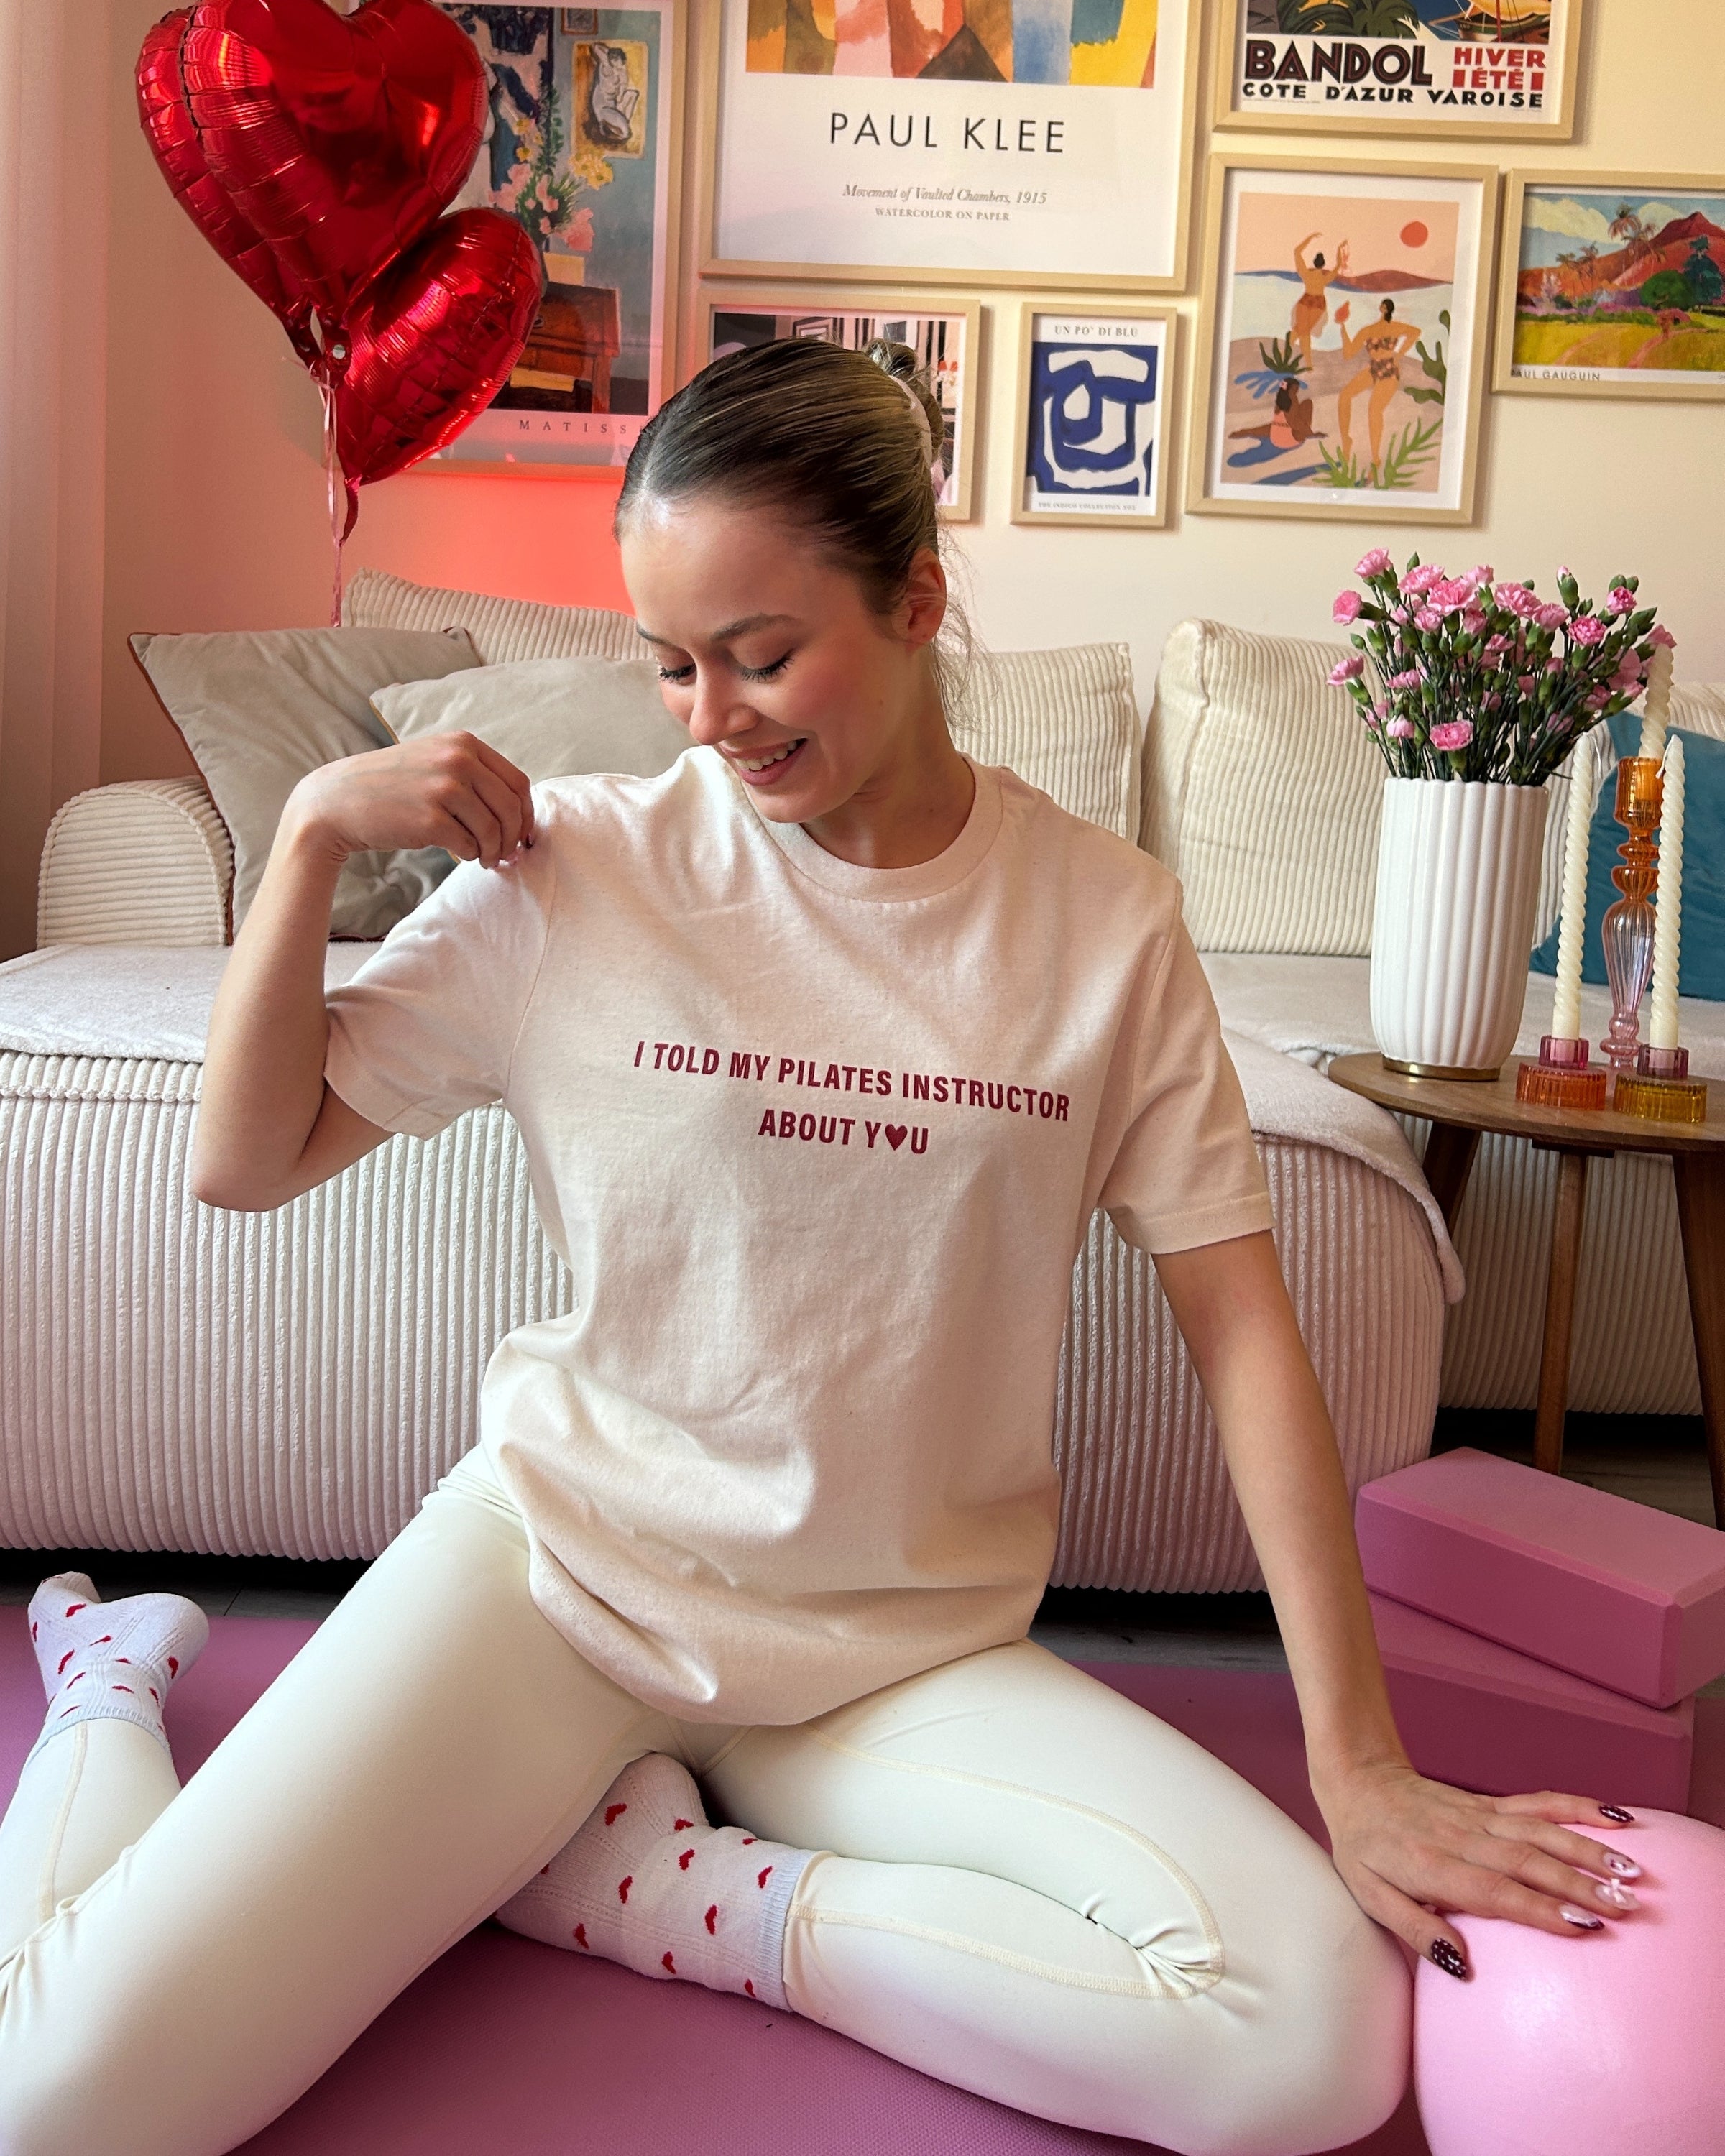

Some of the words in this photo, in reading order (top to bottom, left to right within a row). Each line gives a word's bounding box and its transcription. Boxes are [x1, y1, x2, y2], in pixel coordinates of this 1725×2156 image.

[1245, 40, 1432, 86] BANDOL
[1454, 47, 1546, 68] HIVER
[1242, 83, 1307, 99] COTE
[1326, 85, 1414, 103] D'AZUR
[1427, 90, 1542, 108] VAROISE
[830, 113, 937, 147] PAUL
[965, 117, 1064, 153] KLEE
[842, 184, 898, 198] Movement
[900, 187, 914, 202] of
[916, 187, 954, 201] Vaulted
[957, 188, 1011, 204] Chambers,
[1016, 191, 1047, 204] 1915
[875, 208, 952, 218] WATERCOLOR
[976, 211, 1009, 221] PAPER
[1054, 326, 1070, 335] UN
[1098, 327, 1112, 336] DI
[1116, 328, 1138, 337] BLU
[1542, 369, 1600, 381] GAUGUIN
[519, 420, 643, 434] MATISS
[634, 1041, 645, 1067] I
[654, 1043, 719, 1074] TOLD
[729, 1052, 770, 1081] MY
[778, 1058, 892, 1096] PILATES
[903, 1073, 1070, 1121] INSTRUCTOR
[758, 1109, 856, 1145] ABOUT
